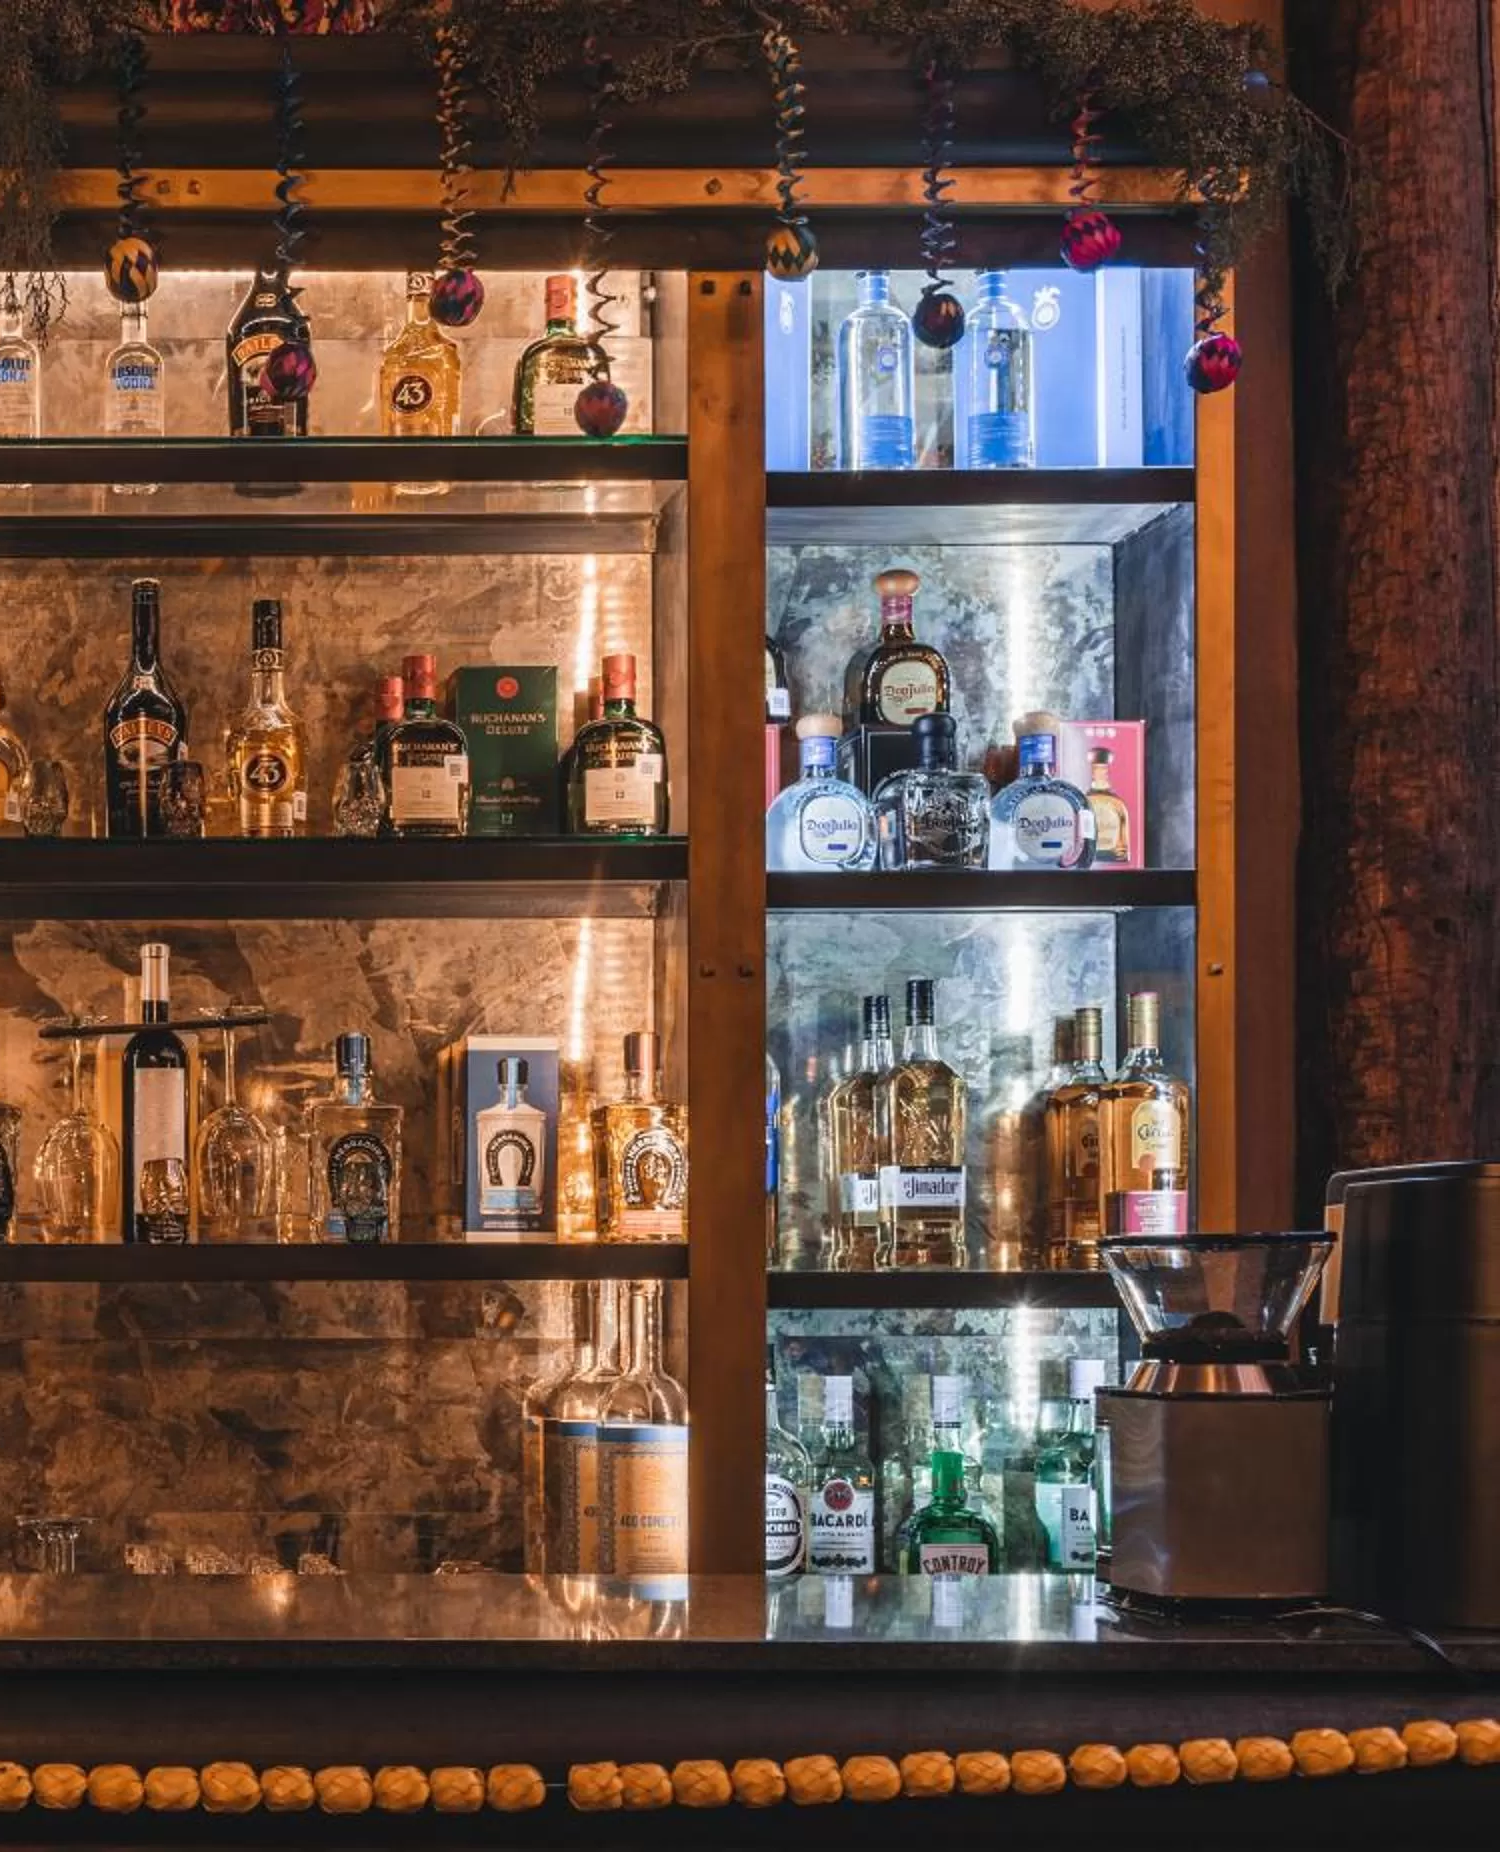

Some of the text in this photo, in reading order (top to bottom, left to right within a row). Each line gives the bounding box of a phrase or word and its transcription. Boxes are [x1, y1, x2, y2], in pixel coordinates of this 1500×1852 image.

[396, 383, 424, 406] 43
[249, 762, 281, 783] 43
[906, 1176, 959, 1199] Jimador
[922, 1557, 987, 1575] CONTROY
